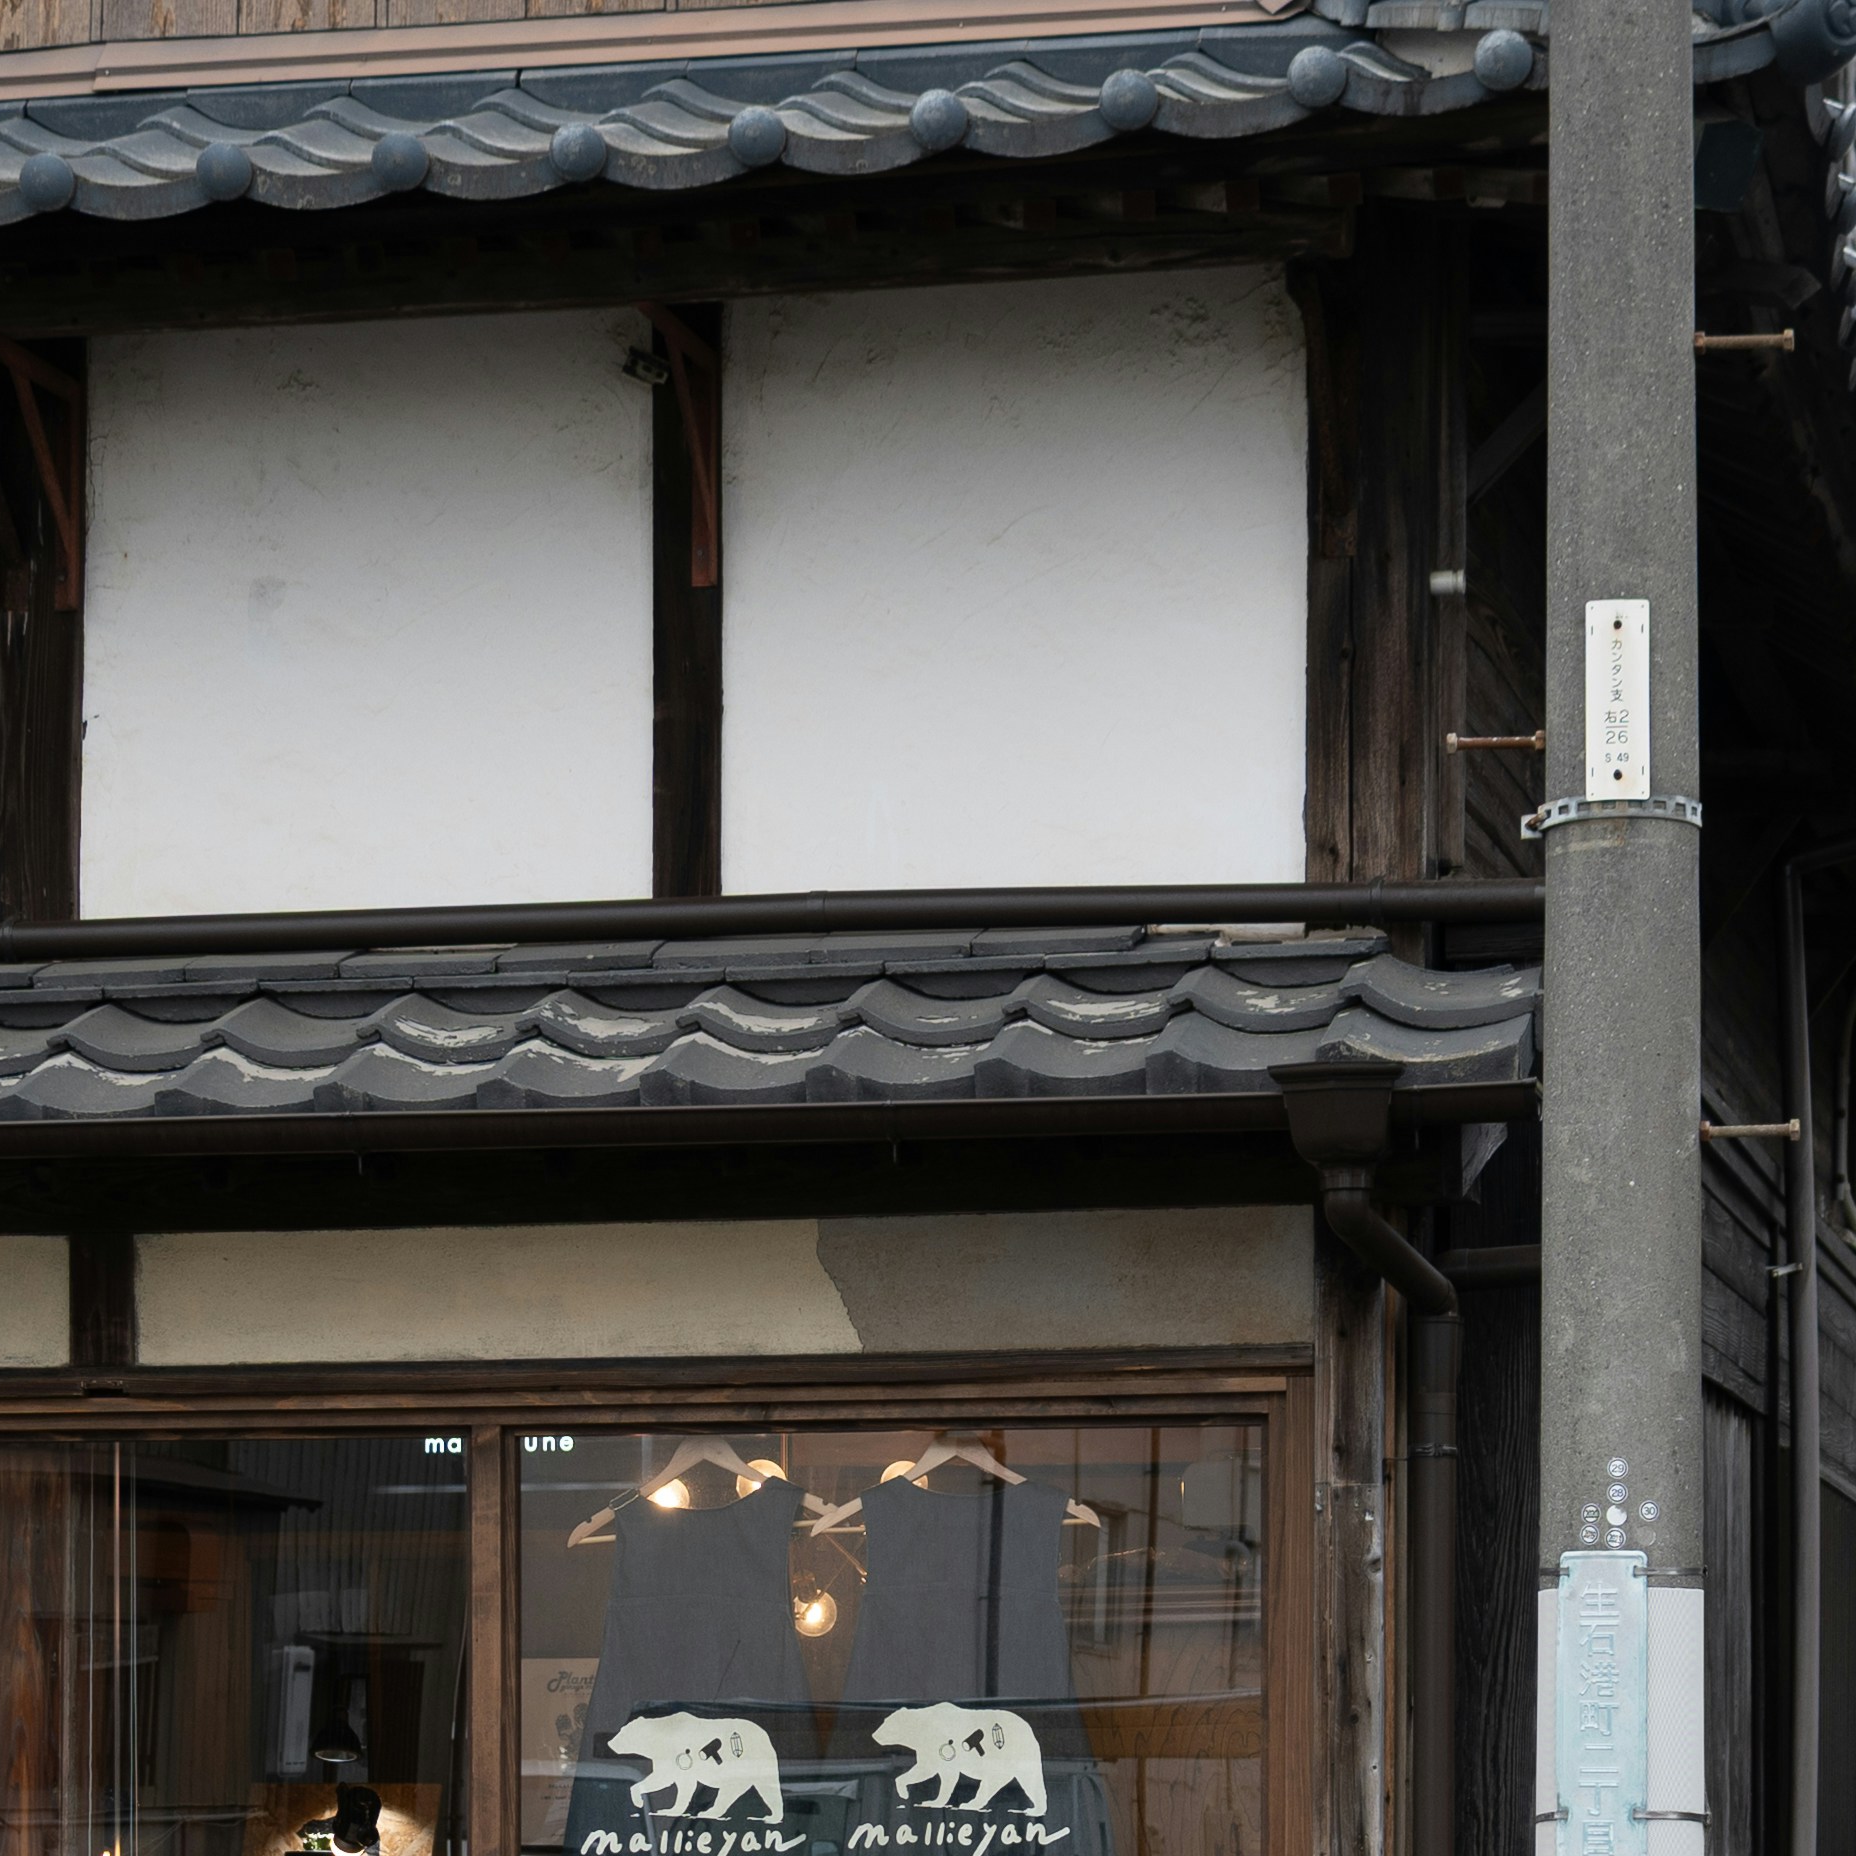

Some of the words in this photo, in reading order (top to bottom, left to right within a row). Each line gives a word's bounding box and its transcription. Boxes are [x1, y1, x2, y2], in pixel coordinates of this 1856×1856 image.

[1606, 730, 1629, 744] 26
[1605, 753, 1612, 763] S
[1617, 752, 1630, 763] 49
[1611, 1463, 1624, 1473] 29
[1611, 1488, 1624, 1498] 28
[1644, 1506, 1656, 1516] 30
[1579, 1580, 1621, 1856] 生石港町二丁目
